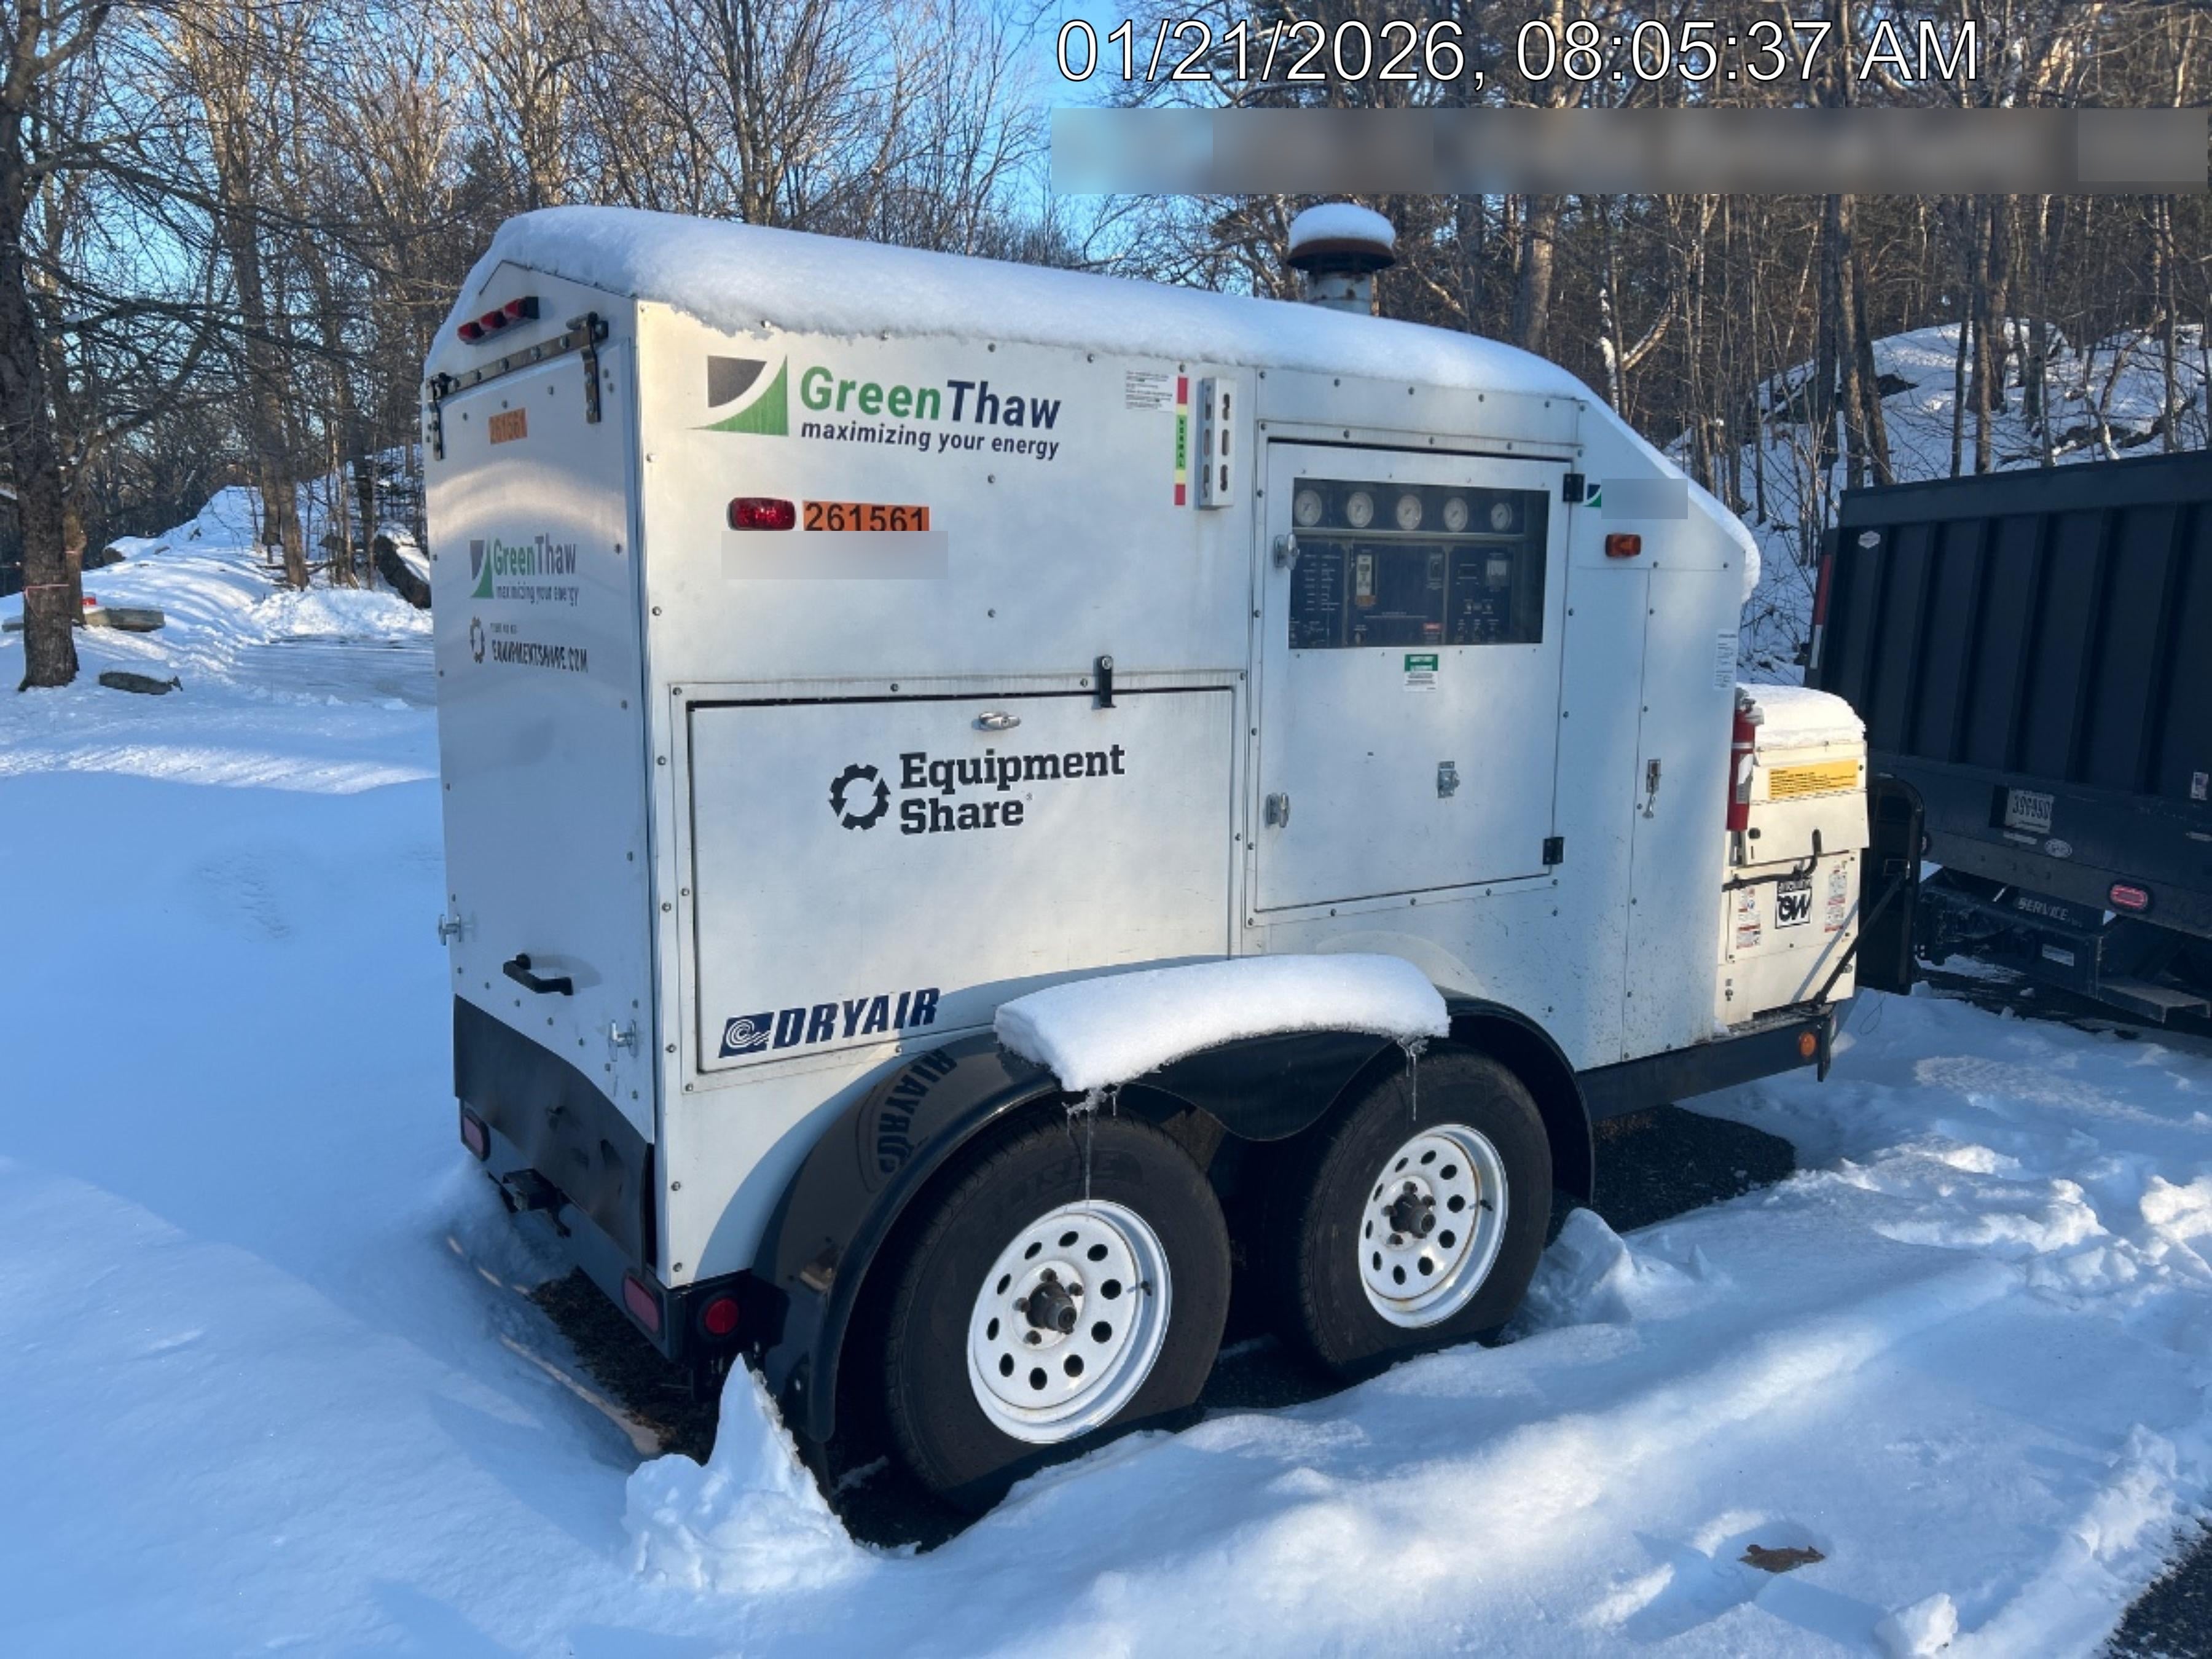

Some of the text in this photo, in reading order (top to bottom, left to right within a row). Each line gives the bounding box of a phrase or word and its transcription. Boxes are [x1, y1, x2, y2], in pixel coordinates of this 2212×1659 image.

[800, 366, 1062, 430] GreenThaw
[801, 420, 1060, 461] maximizing your energy
[805, 501, 924, 531] 261561
[493, 532, 576, 576] GreenThaw
[899, 744, 1126, 795] Equipment
[772, 987, 941, 1049] DRYAIR
